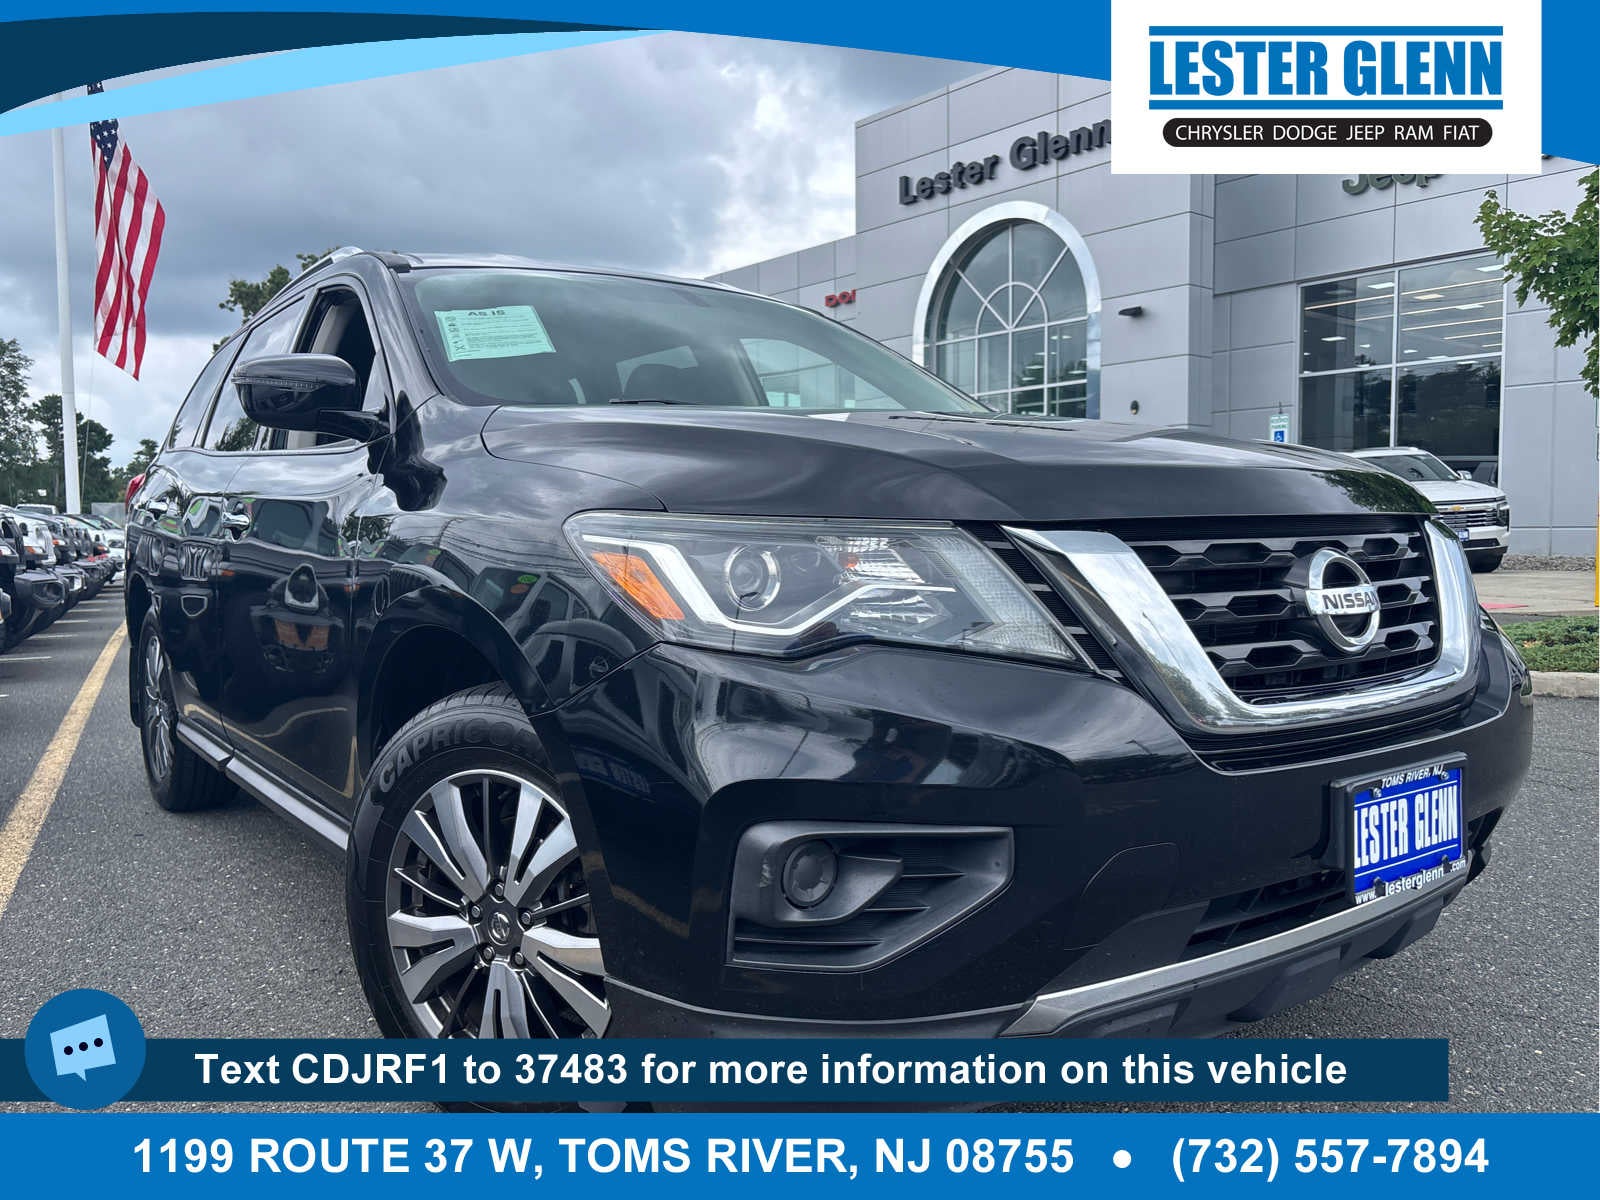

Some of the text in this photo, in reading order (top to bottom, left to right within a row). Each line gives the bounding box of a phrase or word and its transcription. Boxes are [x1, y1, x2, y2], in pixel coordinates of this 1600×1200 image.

[899, 118, 1112, 205] Lester Glenn
[1322, 590, 1379, 611] NISSAN
[1381, 774, 1404, 788] TOMS
[1432, 765, 1444, 777] NJ
[1354, 784, 1457, 869] LESTER GLENN
